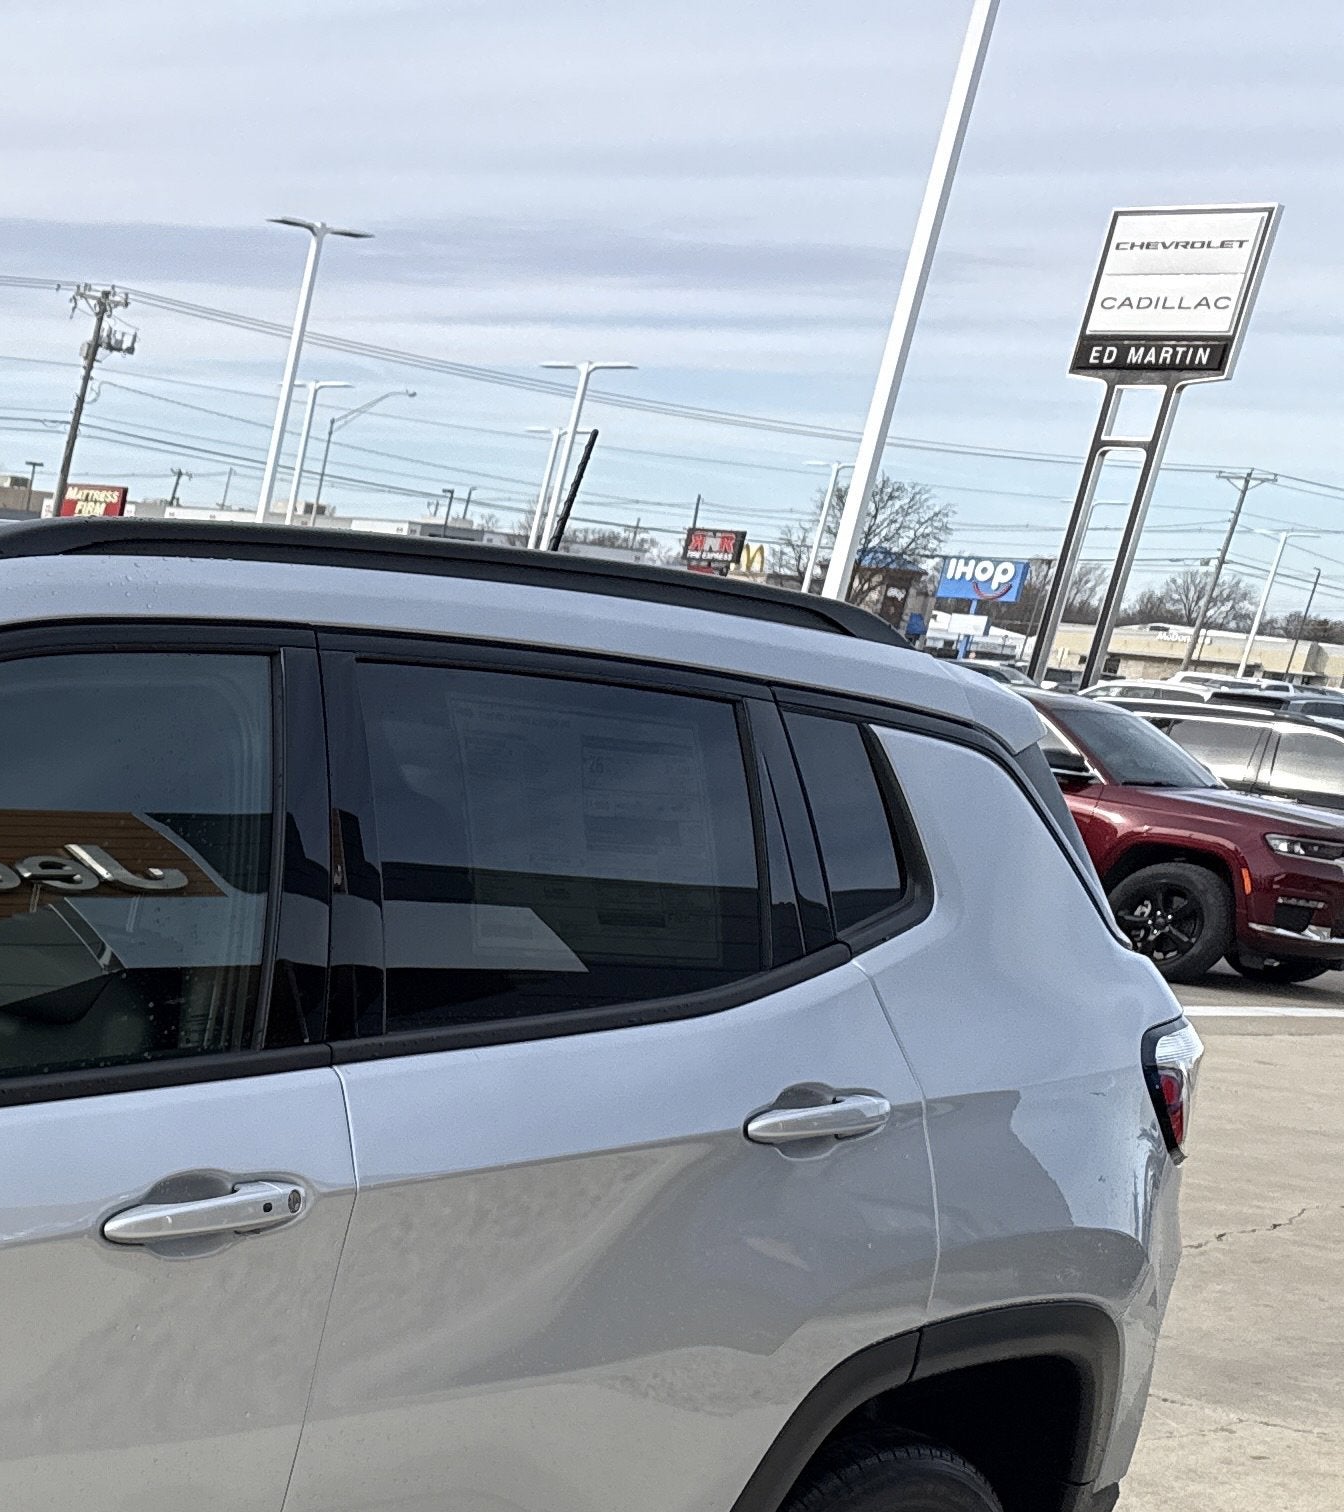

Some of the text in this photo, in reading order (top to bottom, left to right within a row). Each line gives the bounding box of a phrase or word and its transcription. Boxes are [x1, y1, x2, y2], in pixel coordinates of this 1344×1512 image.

[1115, 239, 1250, 251] CHEVROLET
[1100, 296, 1232, 310] CADILLAC
[1089, 346, 1211, 366] ED MARTIN
[64, 486, 120, 504] MATTRESS
[74, 500, 107, 516] FIRM
[946, 558, 1015, 591] IHOP
